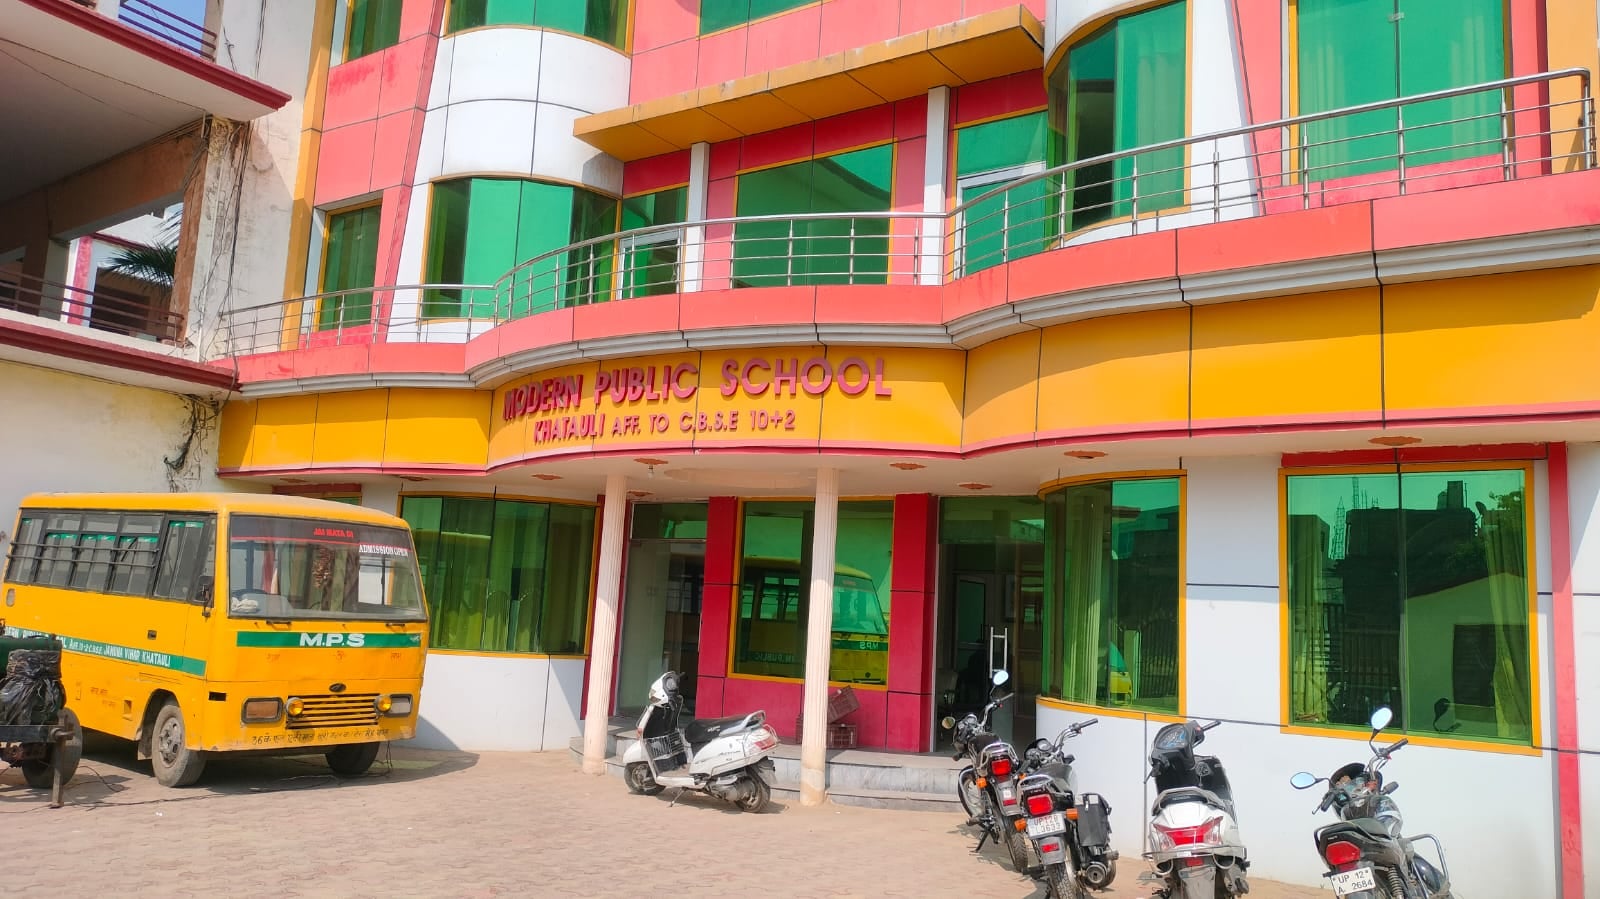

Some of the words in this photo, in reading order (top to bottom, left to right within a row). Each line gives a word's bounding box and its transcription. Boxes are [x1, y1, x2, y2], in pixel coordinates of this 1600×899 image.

[503, 374, 584, 420] MODERN
[594, 362, 698, 404] PUBLIC
[720, 356, 892, 396] SCHOOL
[533, 413, 605, 442] KHATAULI
[611, 415, 641, 435] AFF.
[649, 413, 669, 433] TO
[679, 410, 738, 431] C.B.S.E
[750, 409, 796, 430] 10+2
[359, 544, 393, 555] ADMISSION
[393, 547, 409, 557] OPEN
[300, 632, 365, 647] M.P.S
[142, 651, 171, 668] KHATAULI
[1337, 874, 1350, 884] UP
[1354, 871, 1365, 879] 12
[1351, 879, 1373, 890] 2684
